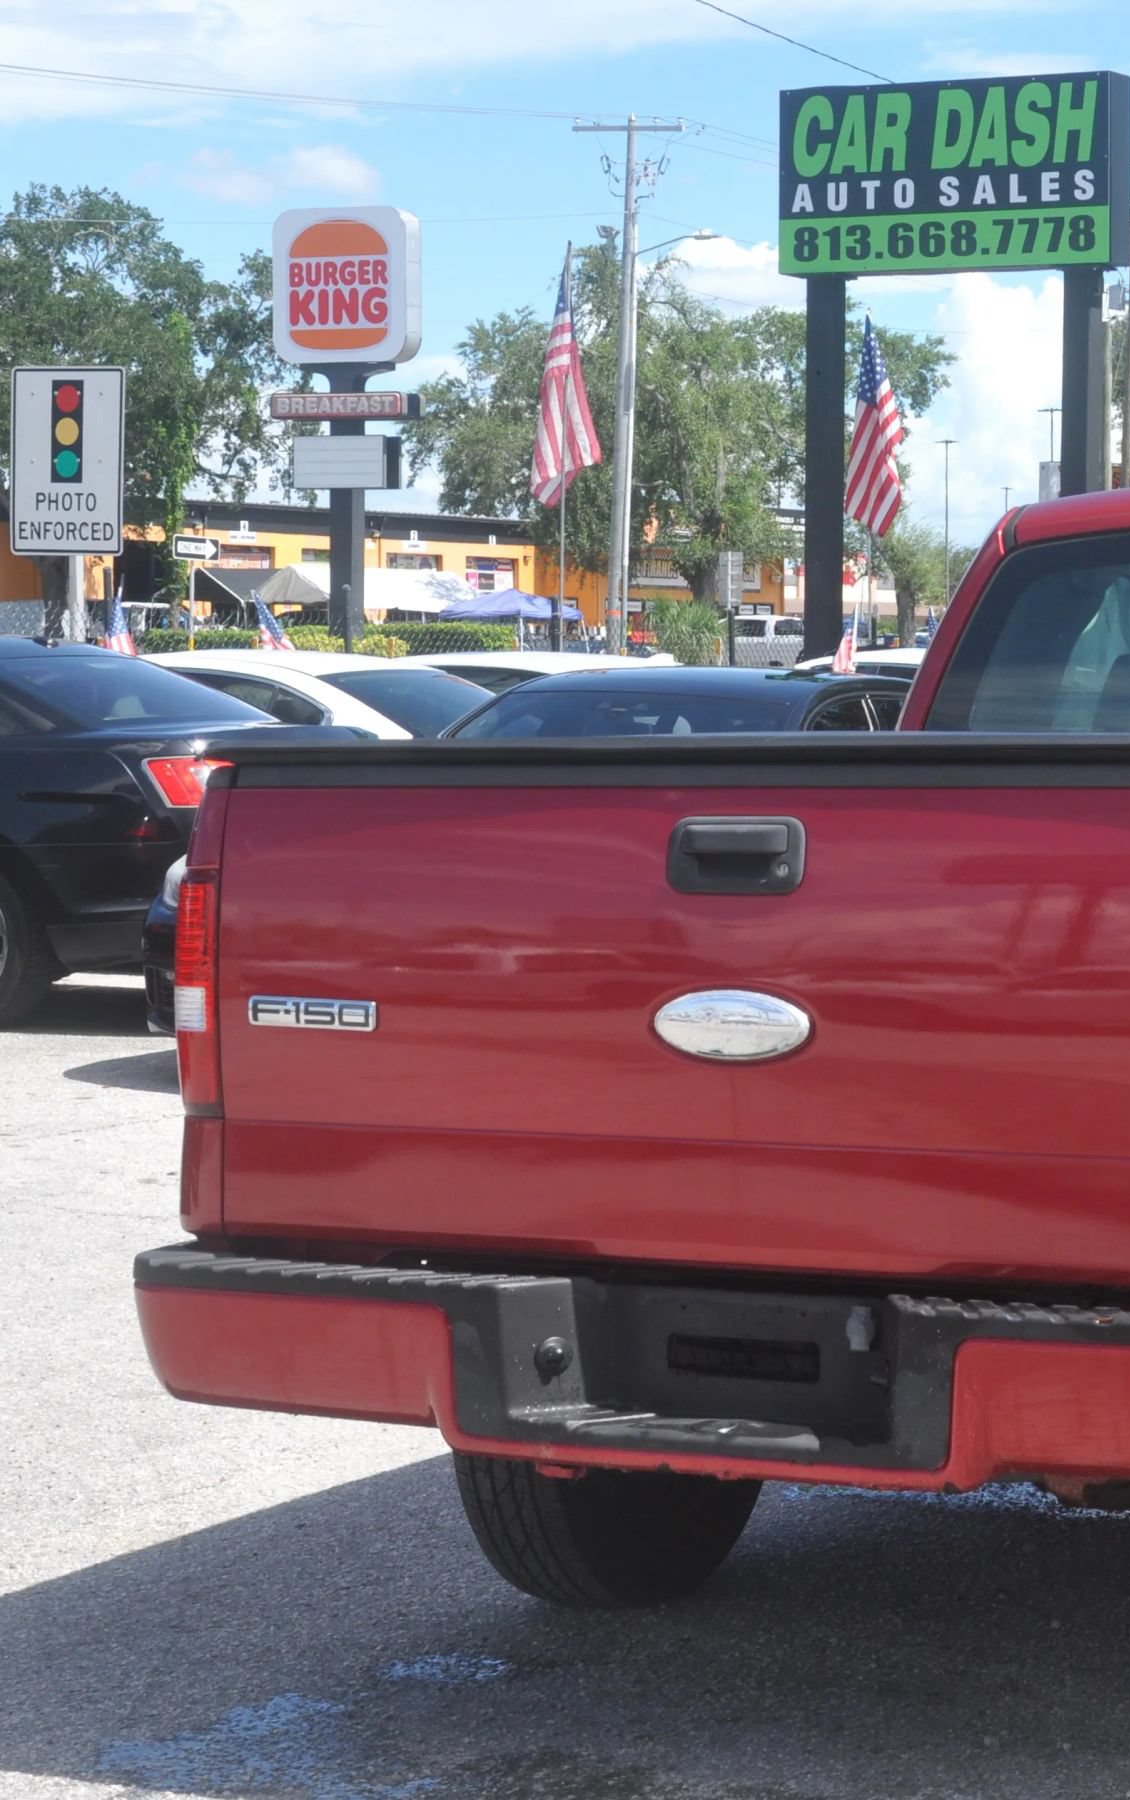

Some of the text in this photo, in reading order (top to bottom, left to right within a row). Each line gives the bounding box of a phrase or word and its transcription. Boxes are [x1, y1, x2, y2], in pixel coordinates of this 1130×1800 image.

[793, 80, 1099, 178] CAR DASH
[792, 169, 1095, 213] AUTO SALES
[793, 214, 1096, 263] 813.668.7778
[289, 259, 389, 288] BURGER
[289, 287, 389, 327] KING
[276, 396, 396, 414] BREAKFAST
[35, 492, 97, 512] PHOTO
[18, 521, 114, 541] ENFORCED
